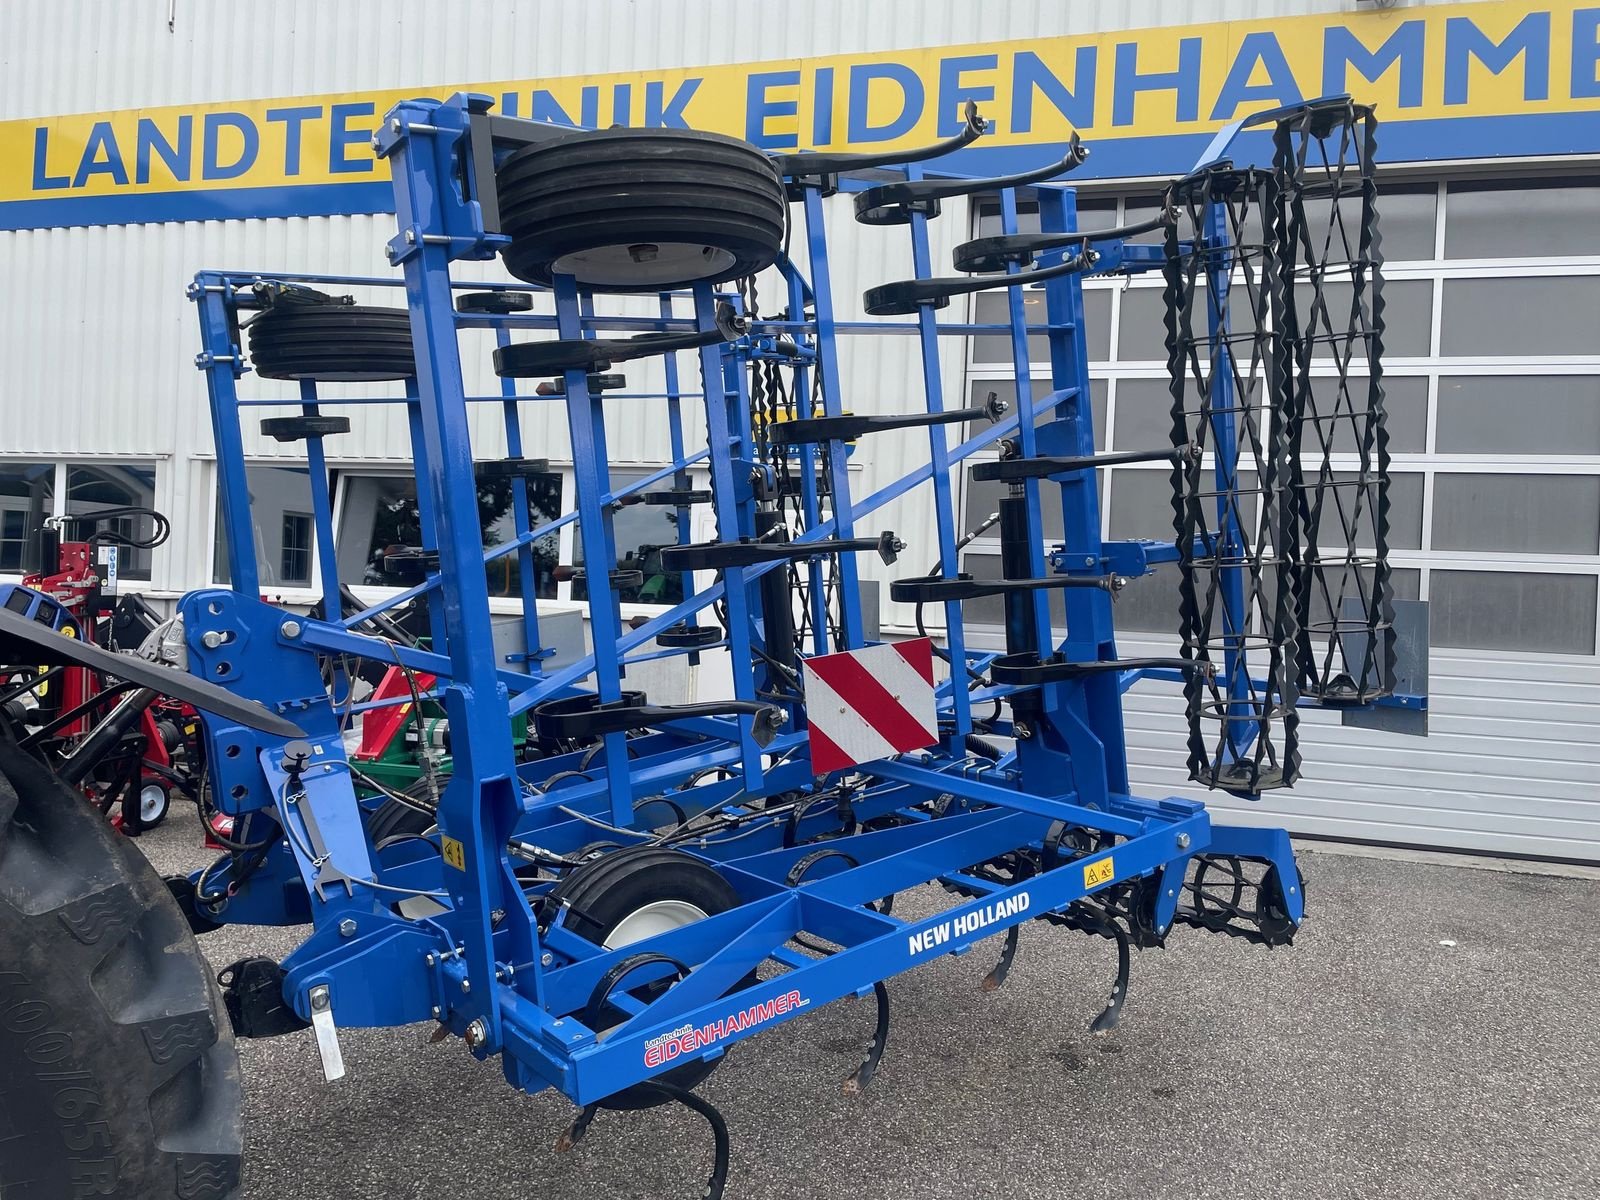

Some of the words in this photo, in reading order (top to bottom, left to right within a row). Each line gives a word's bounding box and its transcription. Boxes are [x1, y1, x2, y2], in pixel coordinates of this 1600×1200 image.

[908, 922, 951, 956] NEW
[953, 891, 1030, 938] HOLLAND
[644, 990, 801, 1068] EIDENHAMMER
[645, 1024, 693, 1049] Landtechnik
